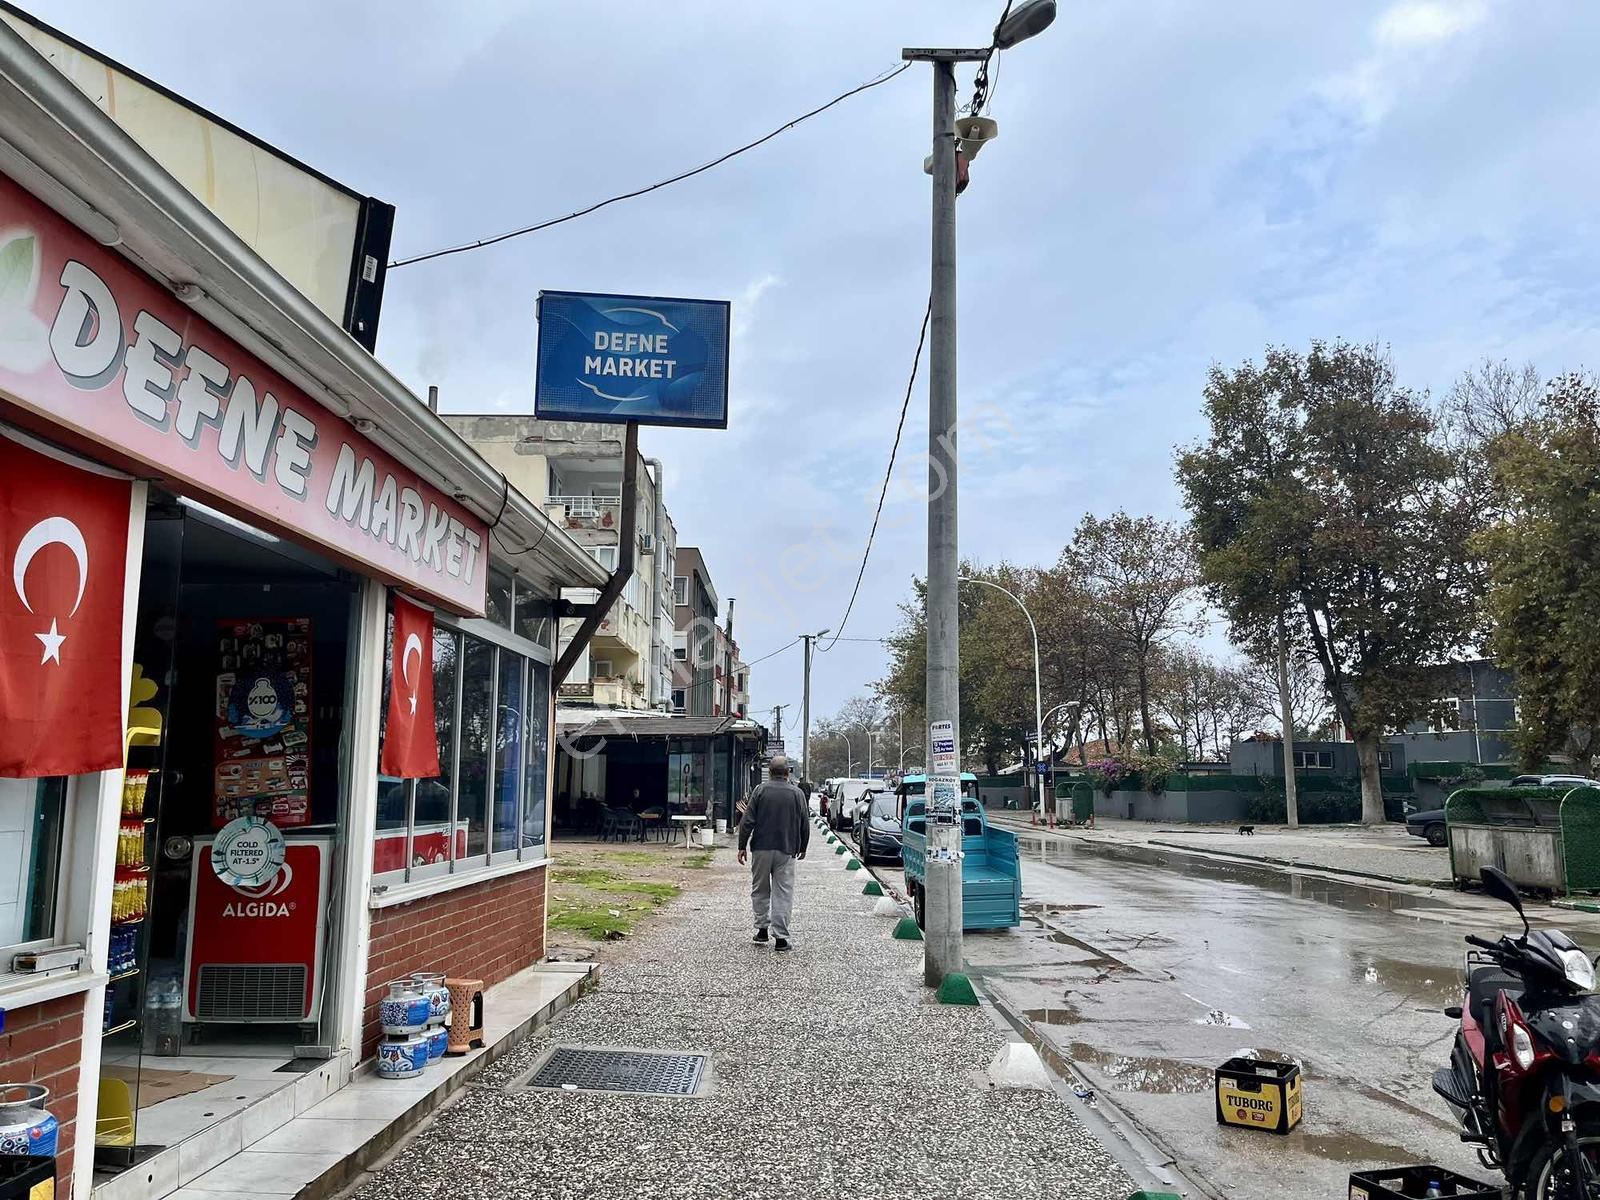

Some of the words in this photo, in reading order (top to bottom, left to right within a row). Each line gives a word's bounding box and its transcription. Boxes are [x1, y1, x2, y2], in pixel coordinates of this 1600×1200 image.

[594, 331, 668, 354] DEFNE
[584, 356, 677, 379] MARKET
[49, 259, 318, 502] DEFNE
[325, 441, 482, 586] MARKET
[230, 849, 263, 857] FILTERED
[1226, 1094, 1273, 1112] TUBORG
